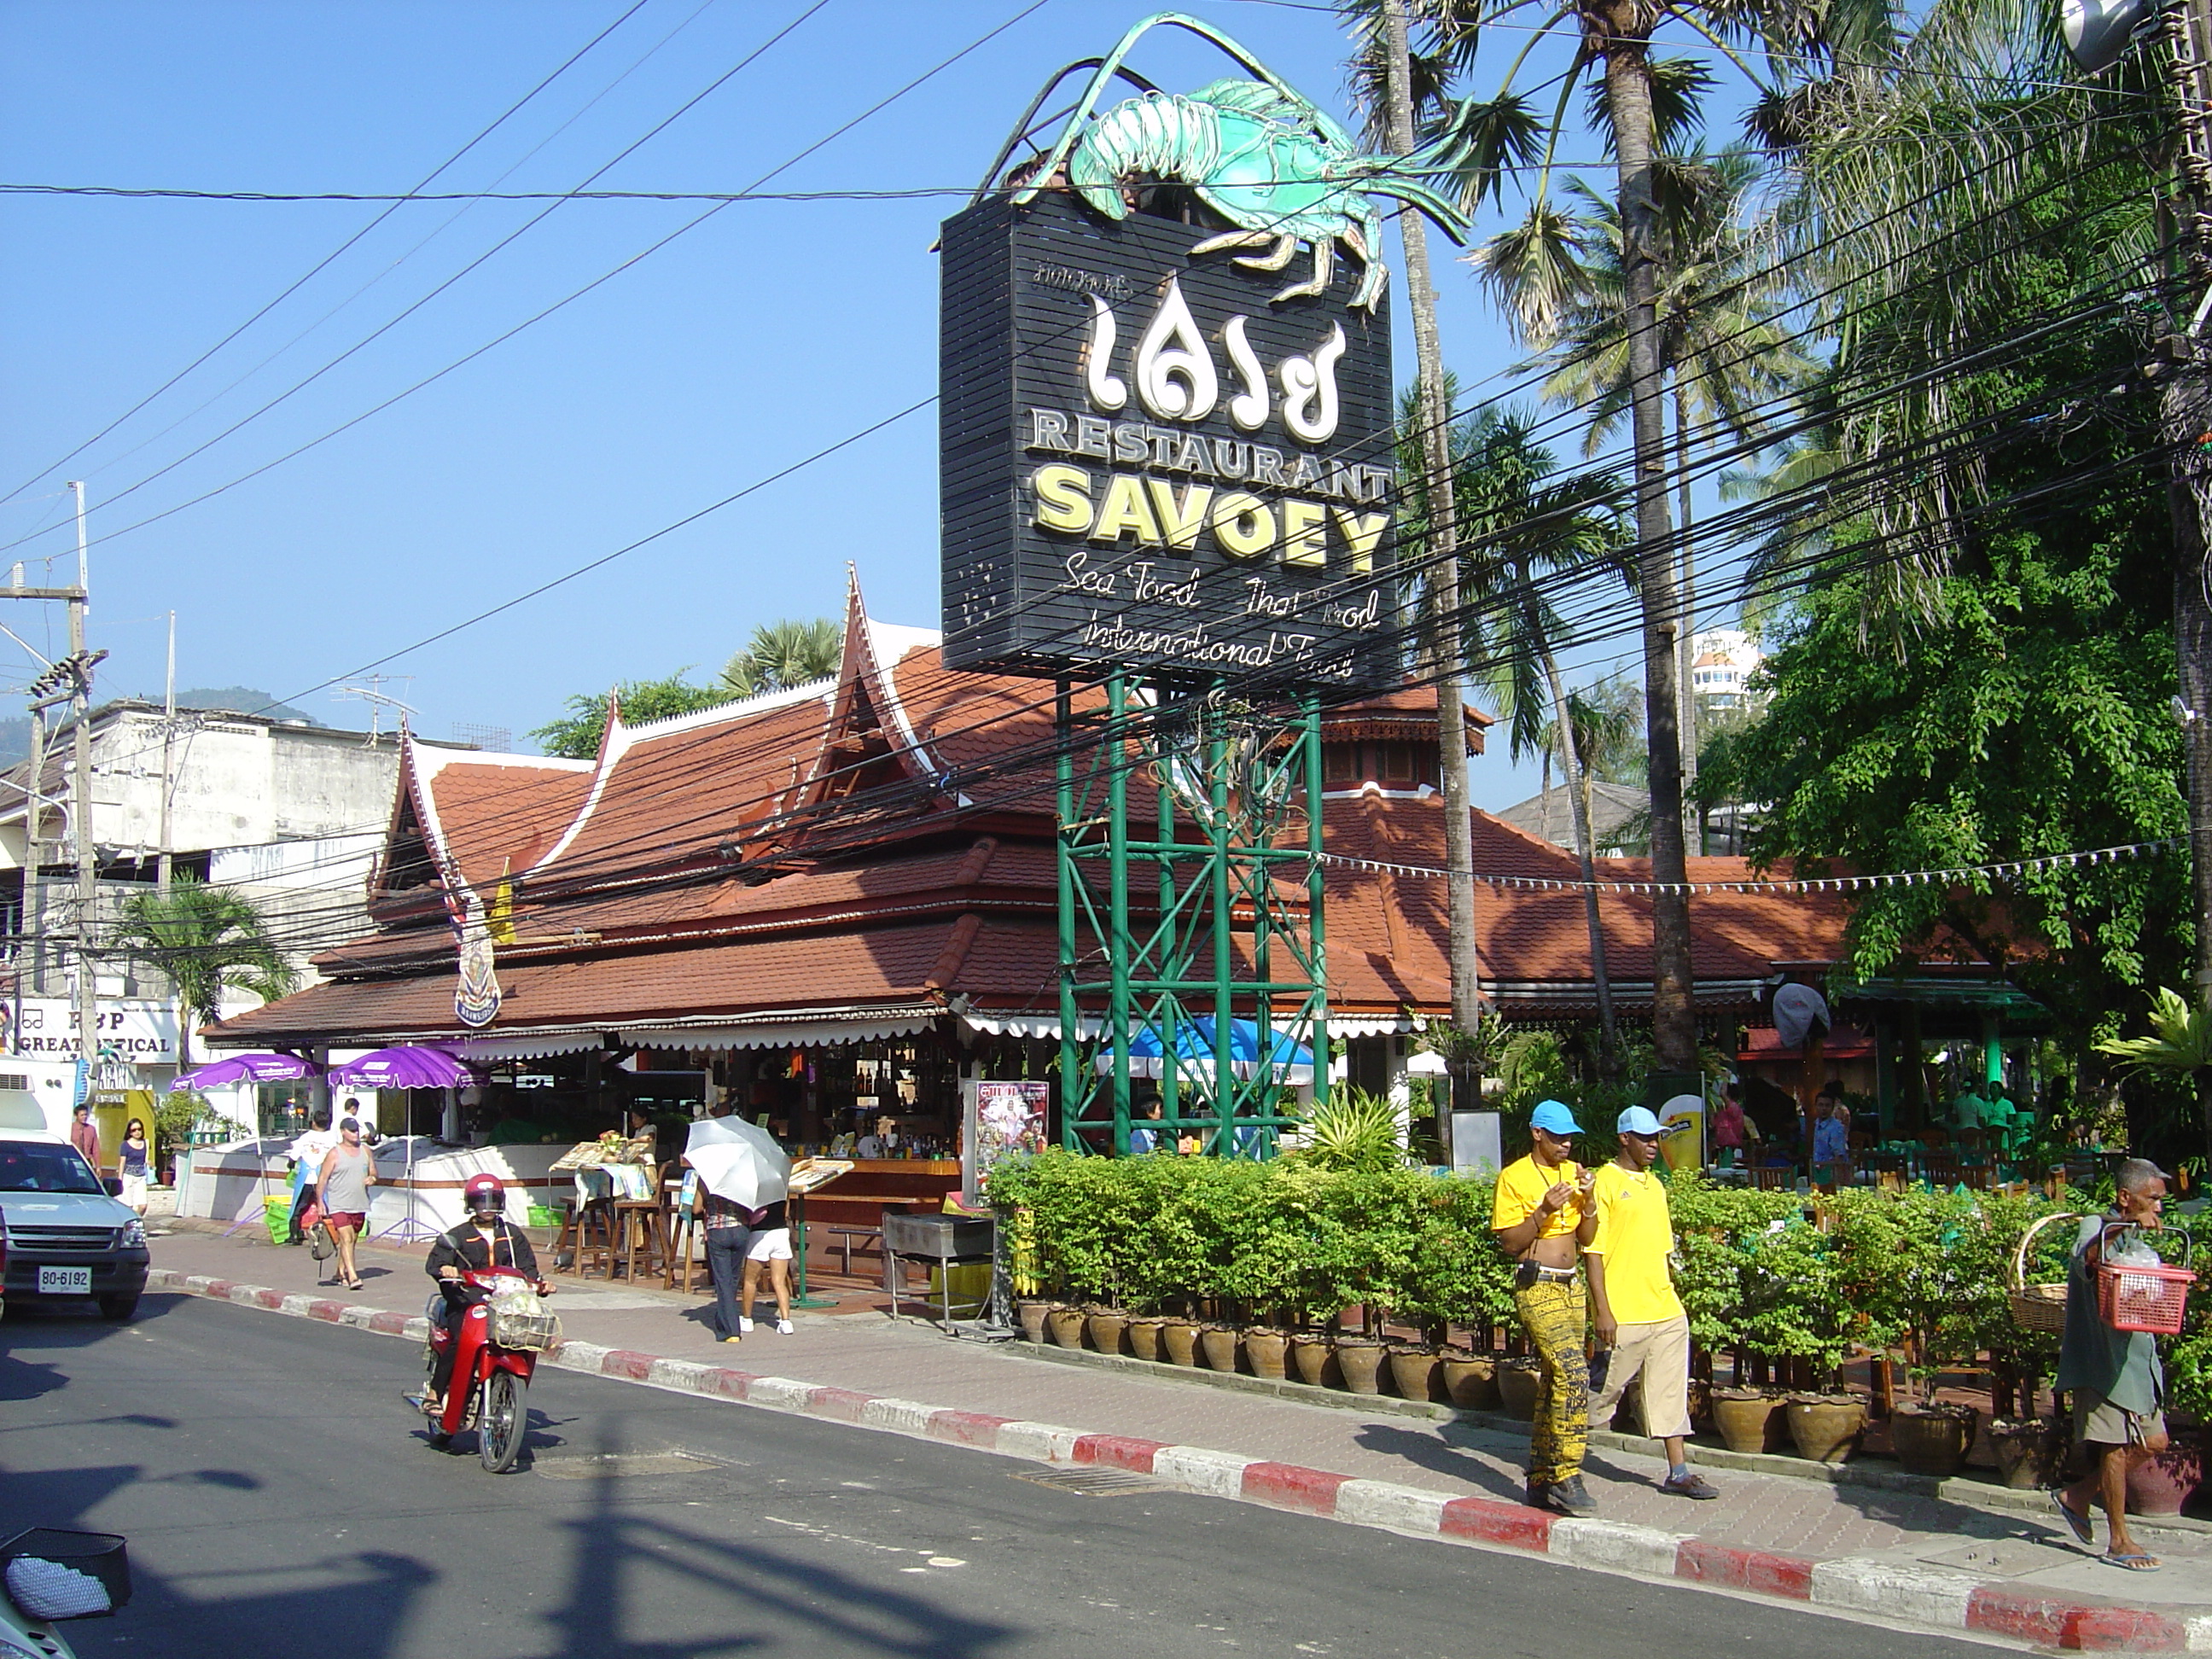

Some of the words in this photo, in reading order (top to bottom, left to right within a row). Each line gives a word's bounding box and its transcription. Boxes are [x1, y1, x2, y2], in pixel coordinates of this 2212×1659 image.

[1025, 408, 1394, 504] RESTAURANT
[1033, 463, 1390, 576] SAVOEY
[1058, 551, 1116, 594] Sea
[1083, 608, 1285, 667] International
[110, 1012, 125, 1029] P
[19, 1037, 82, 1051] GREAT
[42, 1271, 88, 1286] 80-6192
